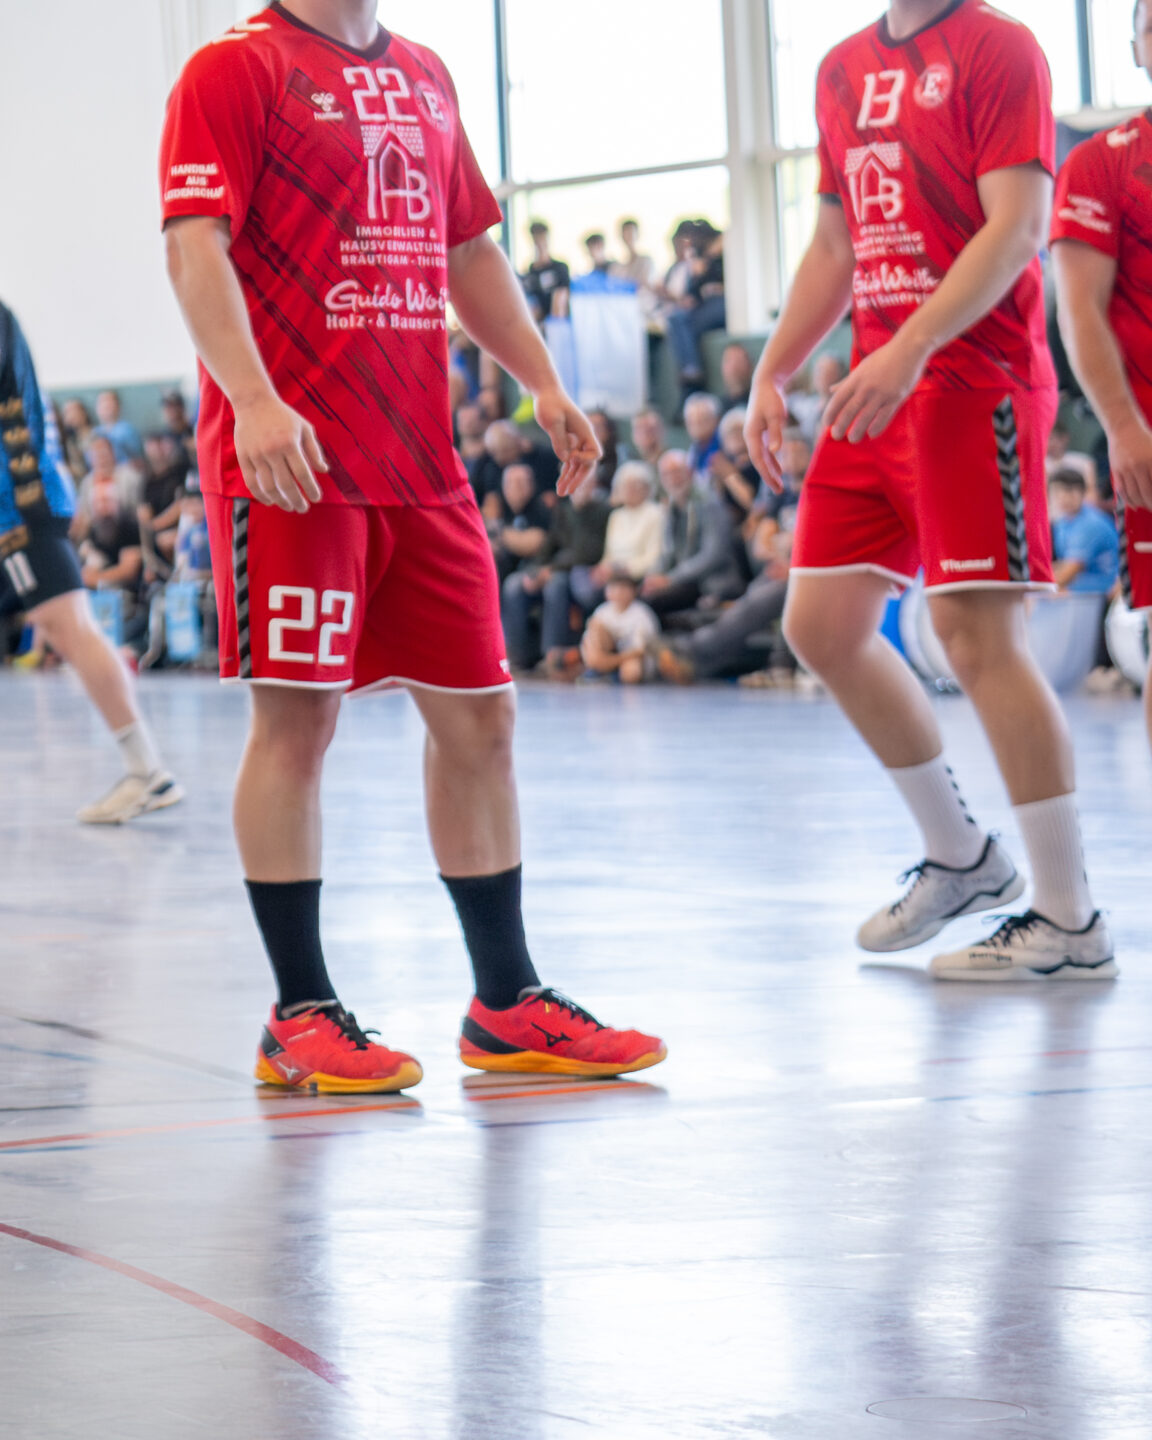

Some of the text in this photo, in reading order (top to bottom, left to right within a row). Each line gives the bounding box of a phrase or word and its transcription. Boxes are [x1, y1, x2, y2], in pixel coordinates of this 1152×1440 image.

[342, 66, 418, 122] 22
[856, 68, 906, 131] 13
[324, 279, 403, 314] Guido
[267, 585, 354, 665] 22
